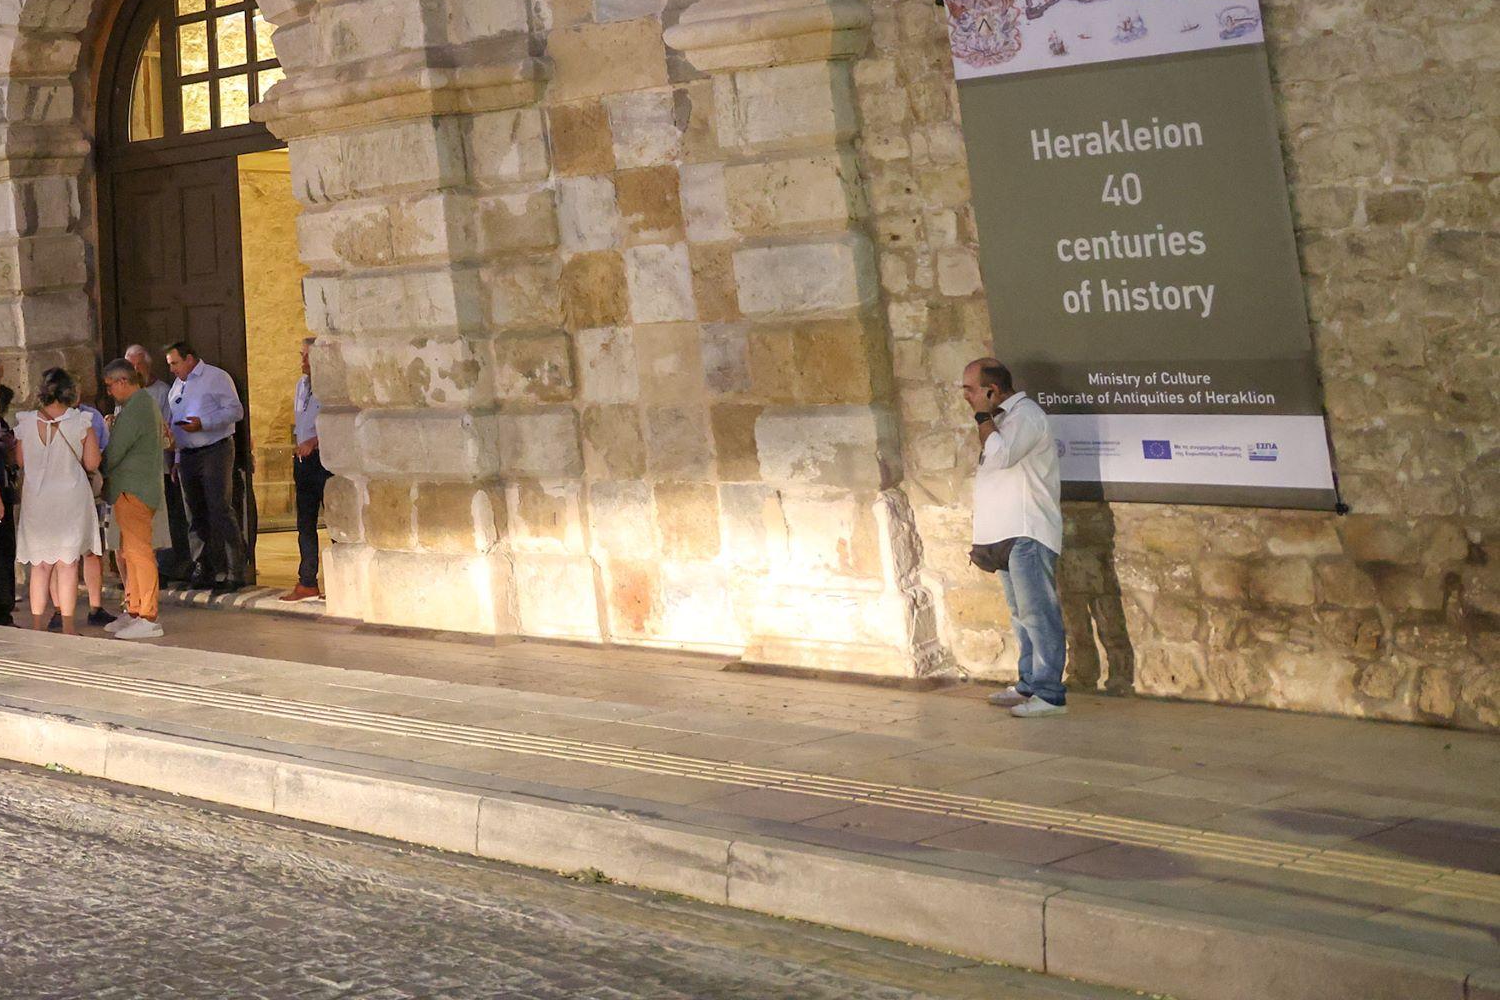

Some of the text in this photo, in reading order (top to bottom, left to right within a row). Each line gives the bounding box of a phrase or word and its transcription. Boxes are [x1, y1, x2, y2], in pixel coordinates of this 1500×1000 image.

[1030, 117, 1203, 160] Herakleion
[1101, 172, 1142, 206] 40
[1056, 224, 1207, 262] centuries
[1062, 279, 1215, 318] of history
[1088, 372, 1211, 388] Ministry of Culture
[1037, 391, 1275, 406] Ephorate of Antiquities of Heraklion
